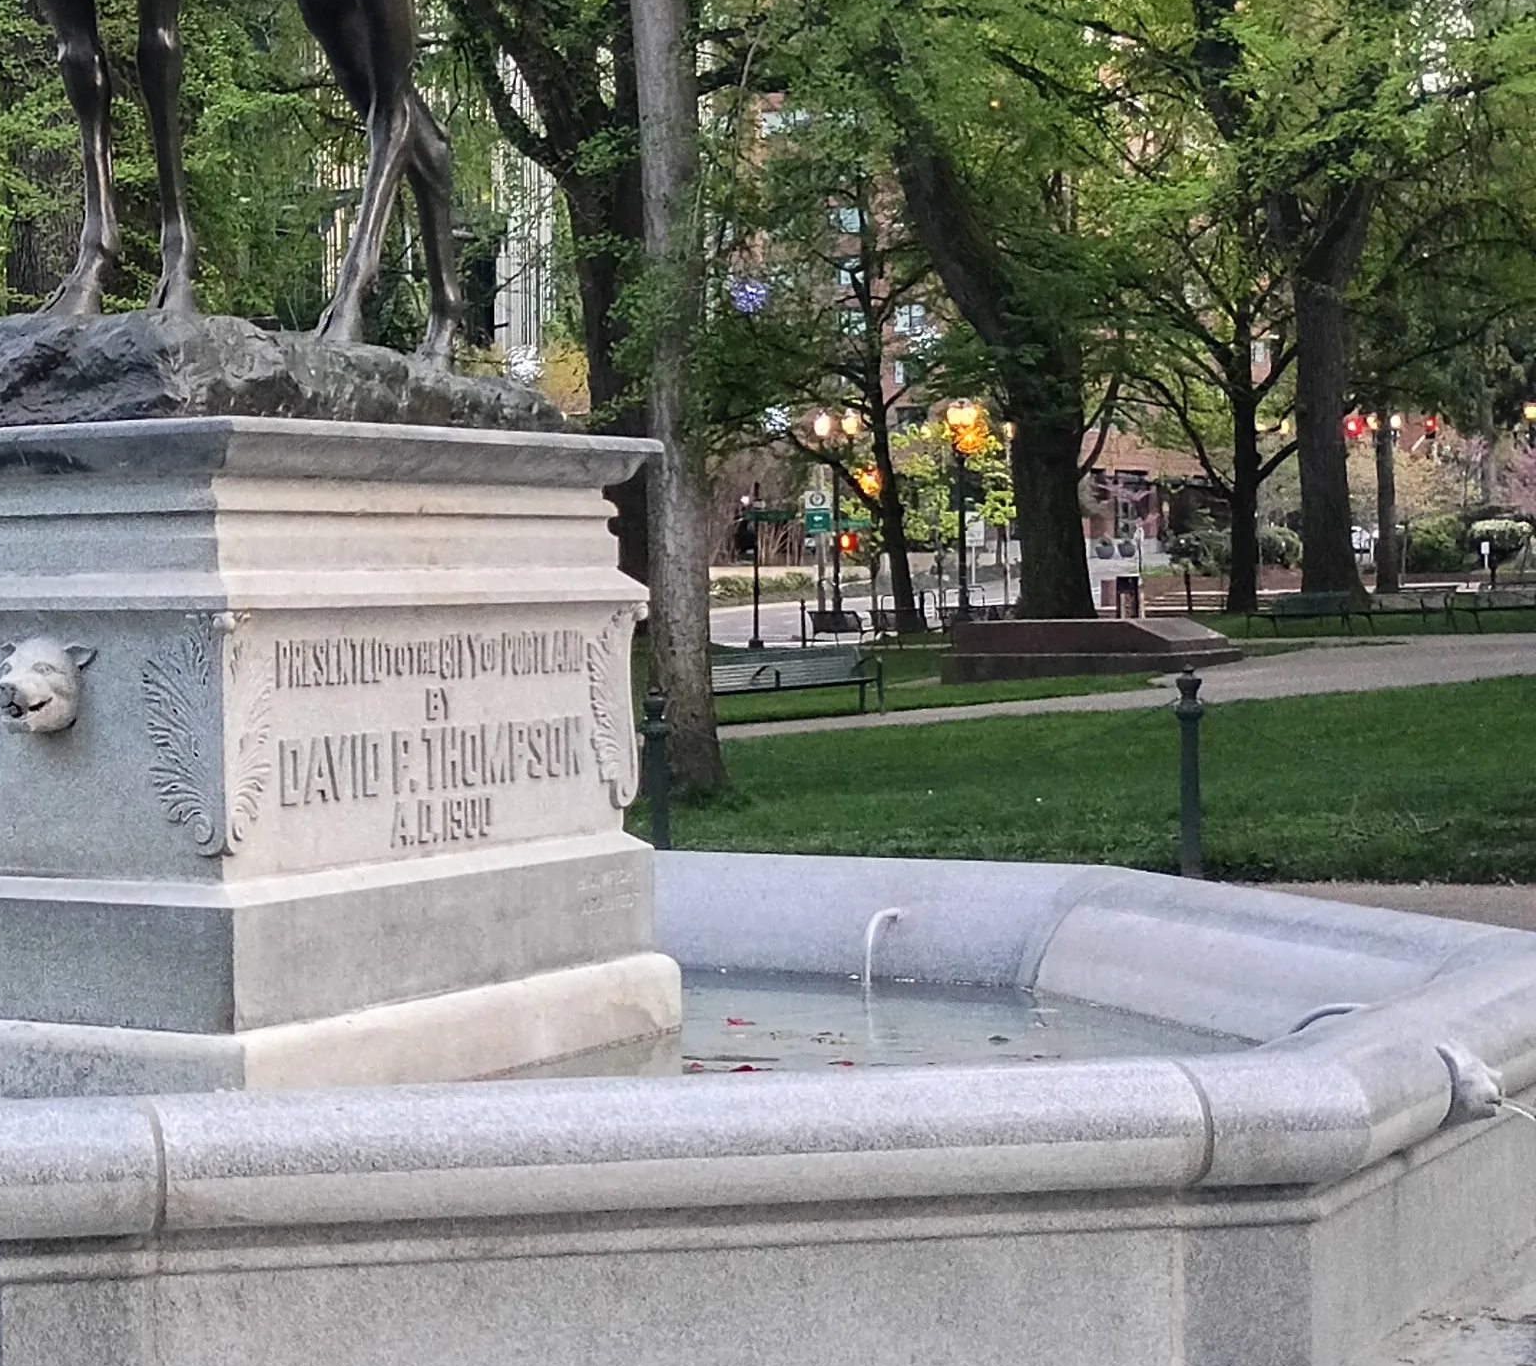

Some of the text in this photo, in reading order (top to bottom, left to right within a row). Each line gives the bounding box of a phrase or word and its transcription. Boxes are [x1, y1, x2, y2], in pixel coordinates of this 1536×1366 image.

[275, 637, 383, 690] PRESENTED
[383, 643, 406, 676] TO
[406, 640, 437, 675] THE
[438, 633, 481, 680] CITY
[501, 630, 584, 676] PORTLAND
[424, 686, 450, 721] BY
[278, 715, 583, 807] DAVID P. THOMPSON
